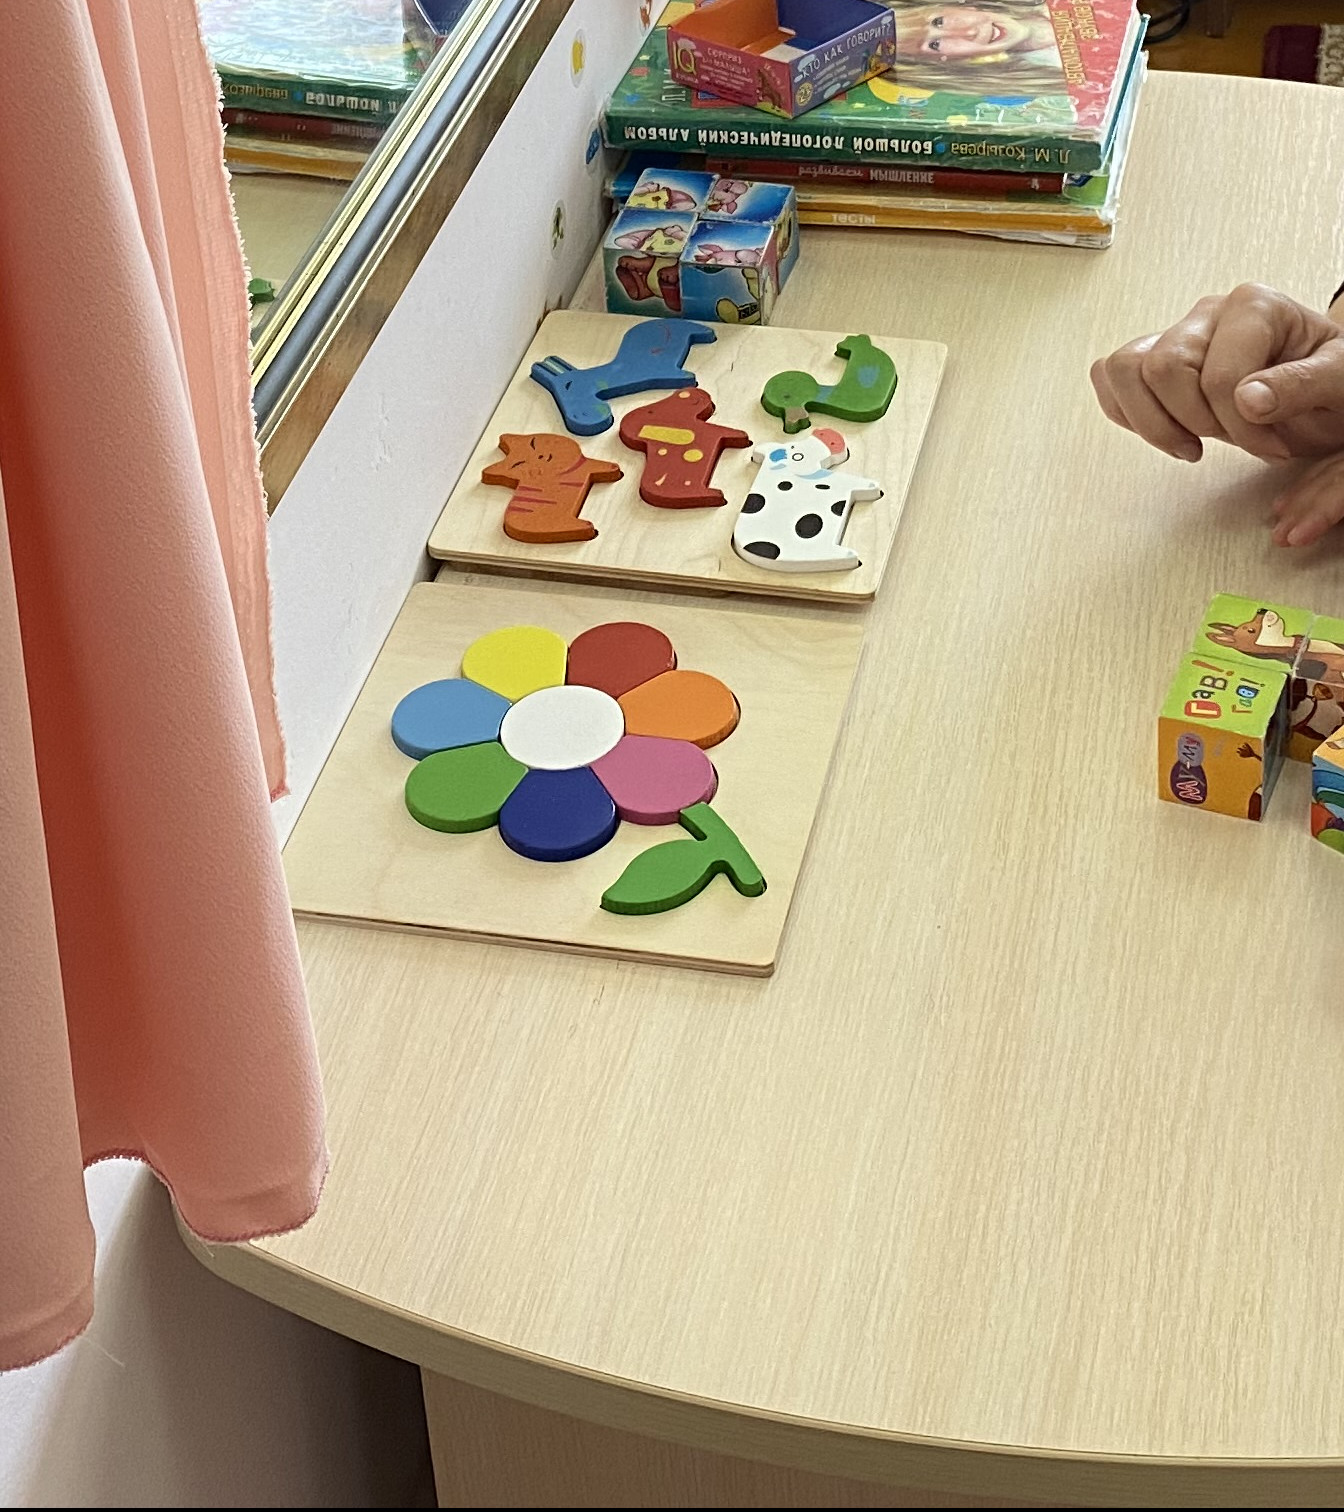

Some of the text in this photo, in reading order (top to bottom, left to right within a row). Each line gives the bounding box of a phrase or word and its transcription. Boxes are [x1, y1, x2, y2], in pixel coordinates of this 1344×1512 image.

[672, 39, 698, 76] IQ
[801, 58, 820, 79] КТО
[824, 44, 843, 63] КАК
[624, 126, 690, 142] АЛЬБОМ
[697, 128, 845, 151] ЛОГОПЕДИЧЕСКИЙ
[852, 135, 934, 155] БОЛЬШОЙ
[950, 141, 1026, 162] Козырева
[869, 168, 935, 184] МЫШЛЕНИЕ
